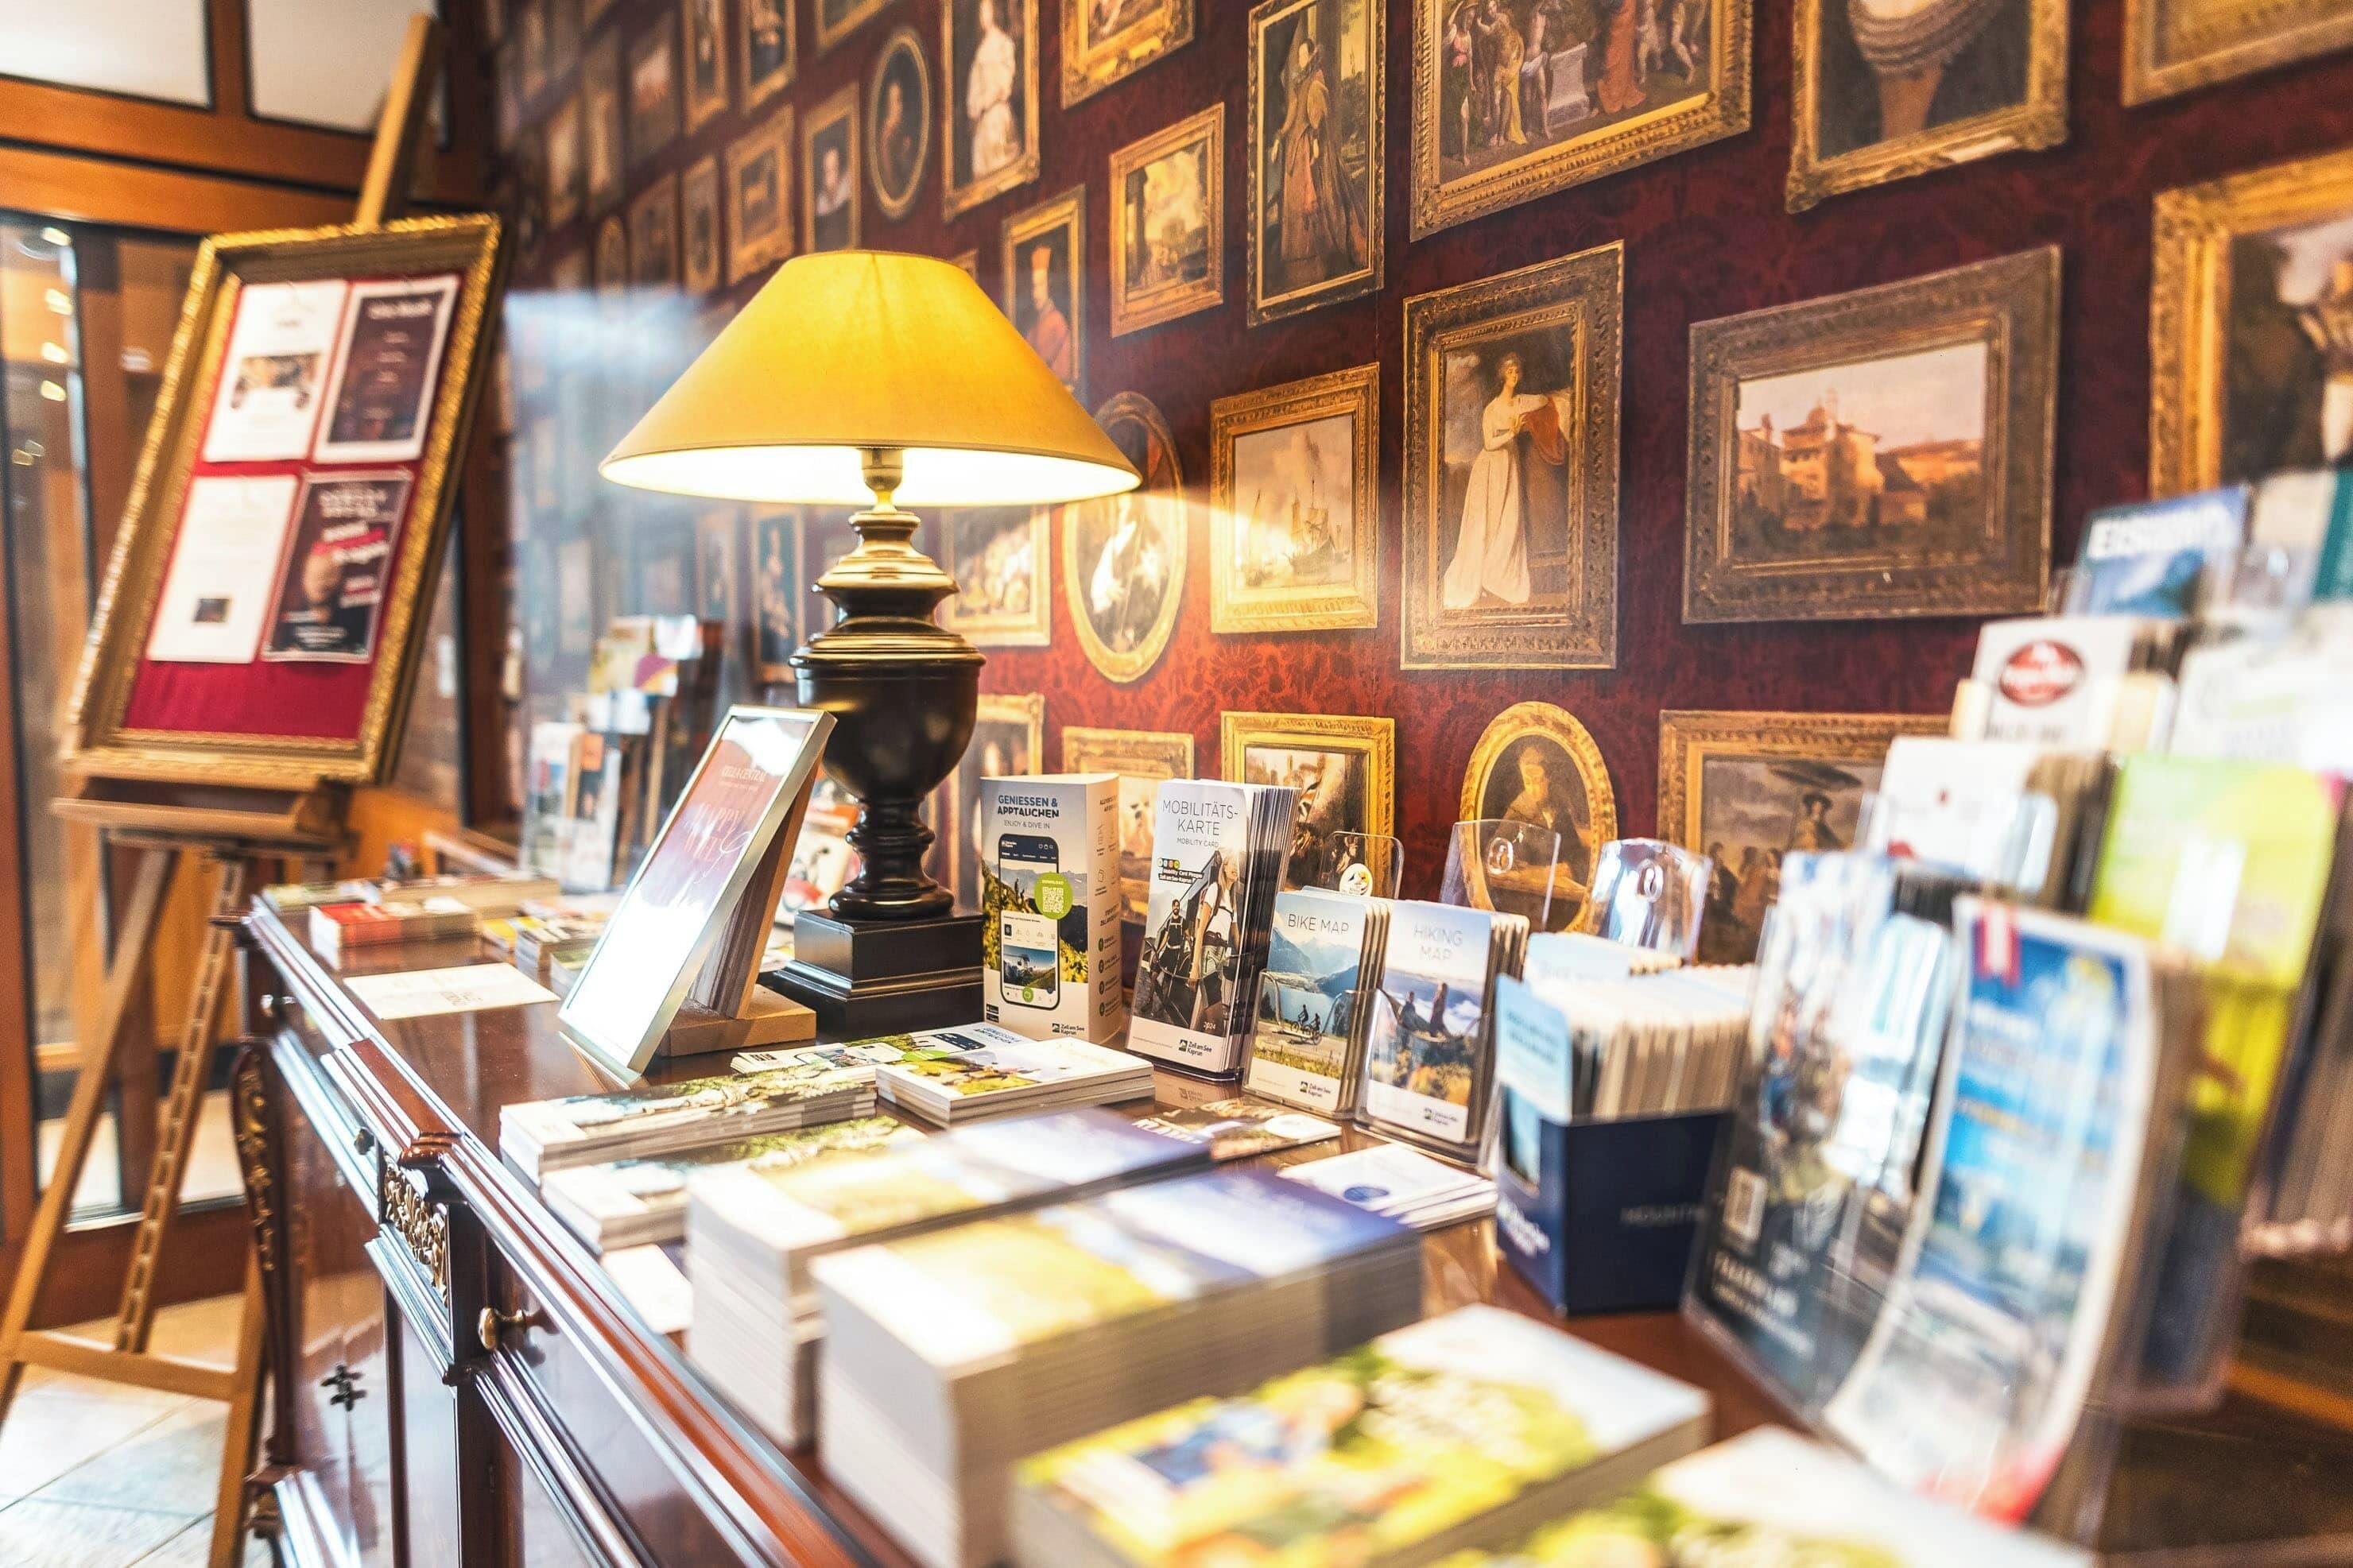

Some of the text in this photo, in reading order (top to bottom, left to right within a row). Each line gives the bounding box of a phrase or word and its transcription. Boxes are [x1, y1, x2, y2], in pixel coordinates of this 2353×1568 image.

[998, 795, 1058, 807] GENIESSEN &
[998, 806, 1059, 818] APPTAUCHEN
[1162, 799, 1238, 819] MOBILITÄTS-
[1177, 818, 1220, 836] KARTE
[1176, 837, 1203, 846] MOBILITY
[1288, 913, 1349, 935] BIKE MAP
[1413, 925, 1463, 947] HIKING
[1420, 946, 1452, 962] MAP
[1187, 1047, 1203, 1056] Kaprun
[1204, 1044, 1212, 1053] See
